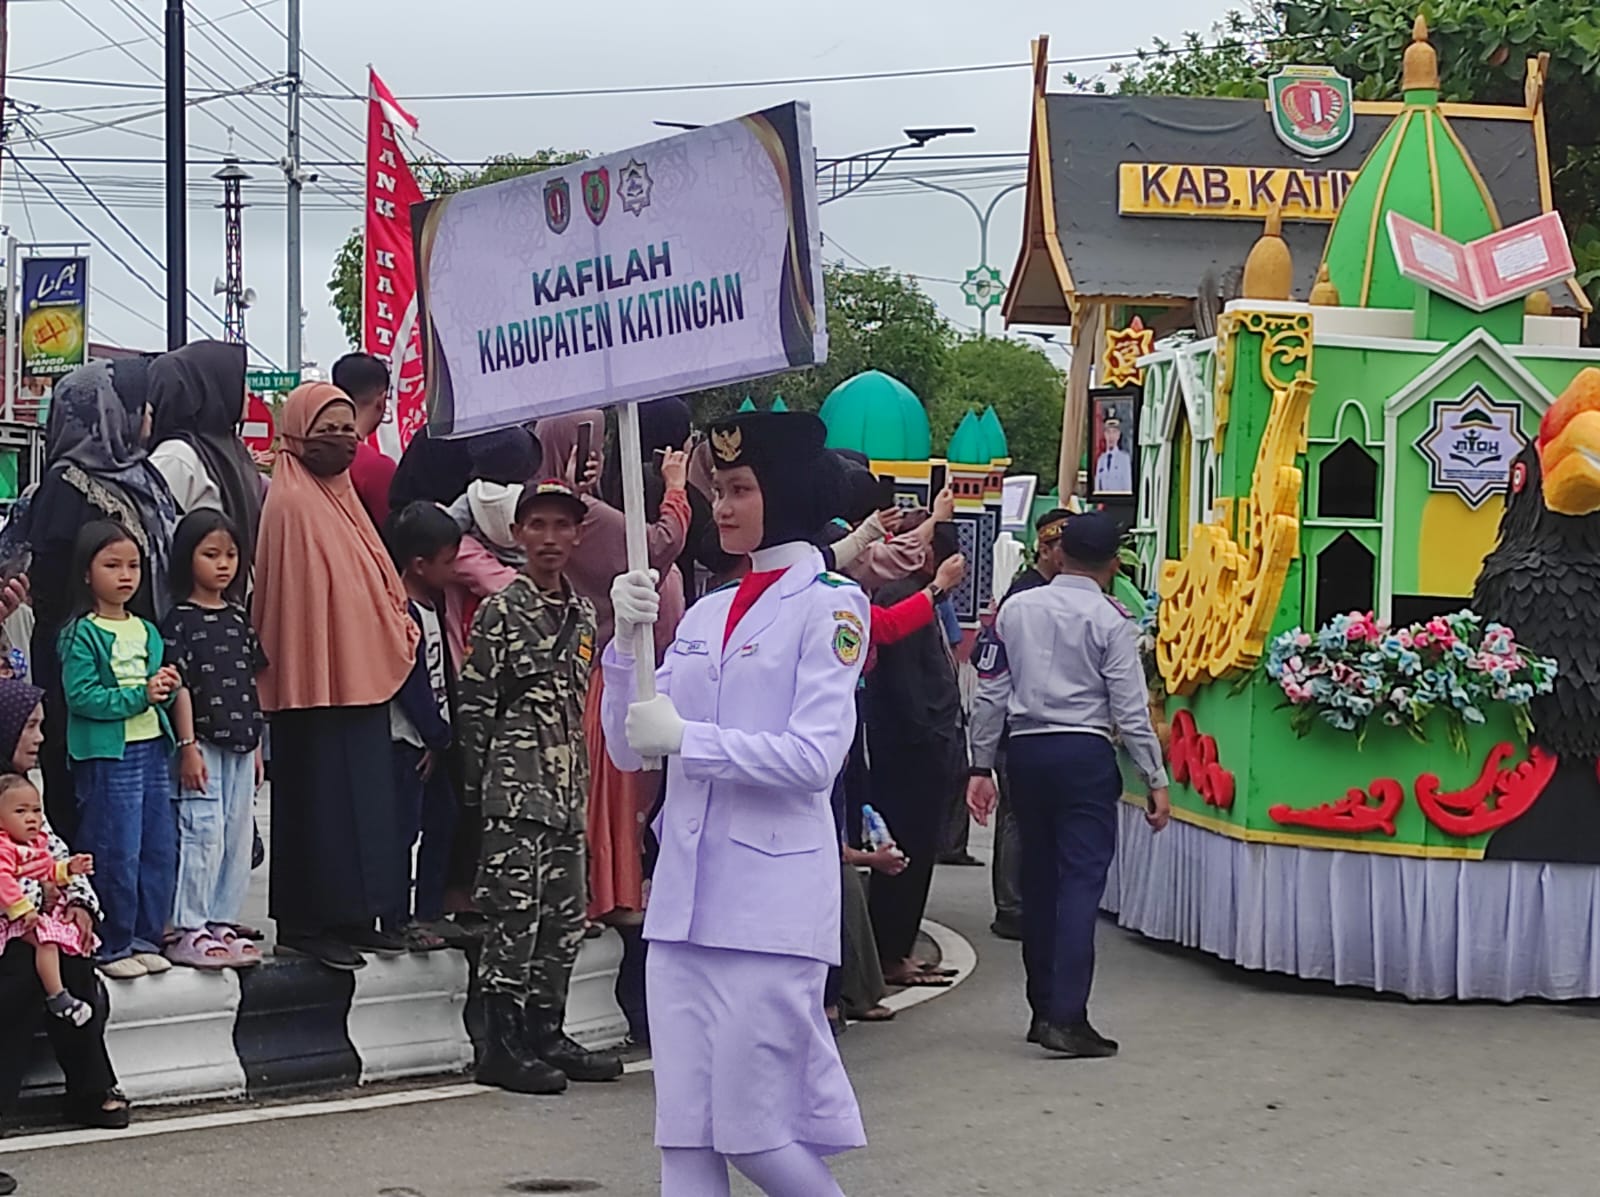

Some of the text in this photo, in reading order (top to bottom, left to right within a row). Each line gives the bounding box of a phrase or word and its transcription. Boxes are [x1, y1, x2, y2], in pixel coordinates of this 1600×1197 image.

[532, 241, 672, 306] KAFILAH
[478, 272, 744, 375] KABUPATEN KATINGAN
[26, 357, 65, 368] MANGO
